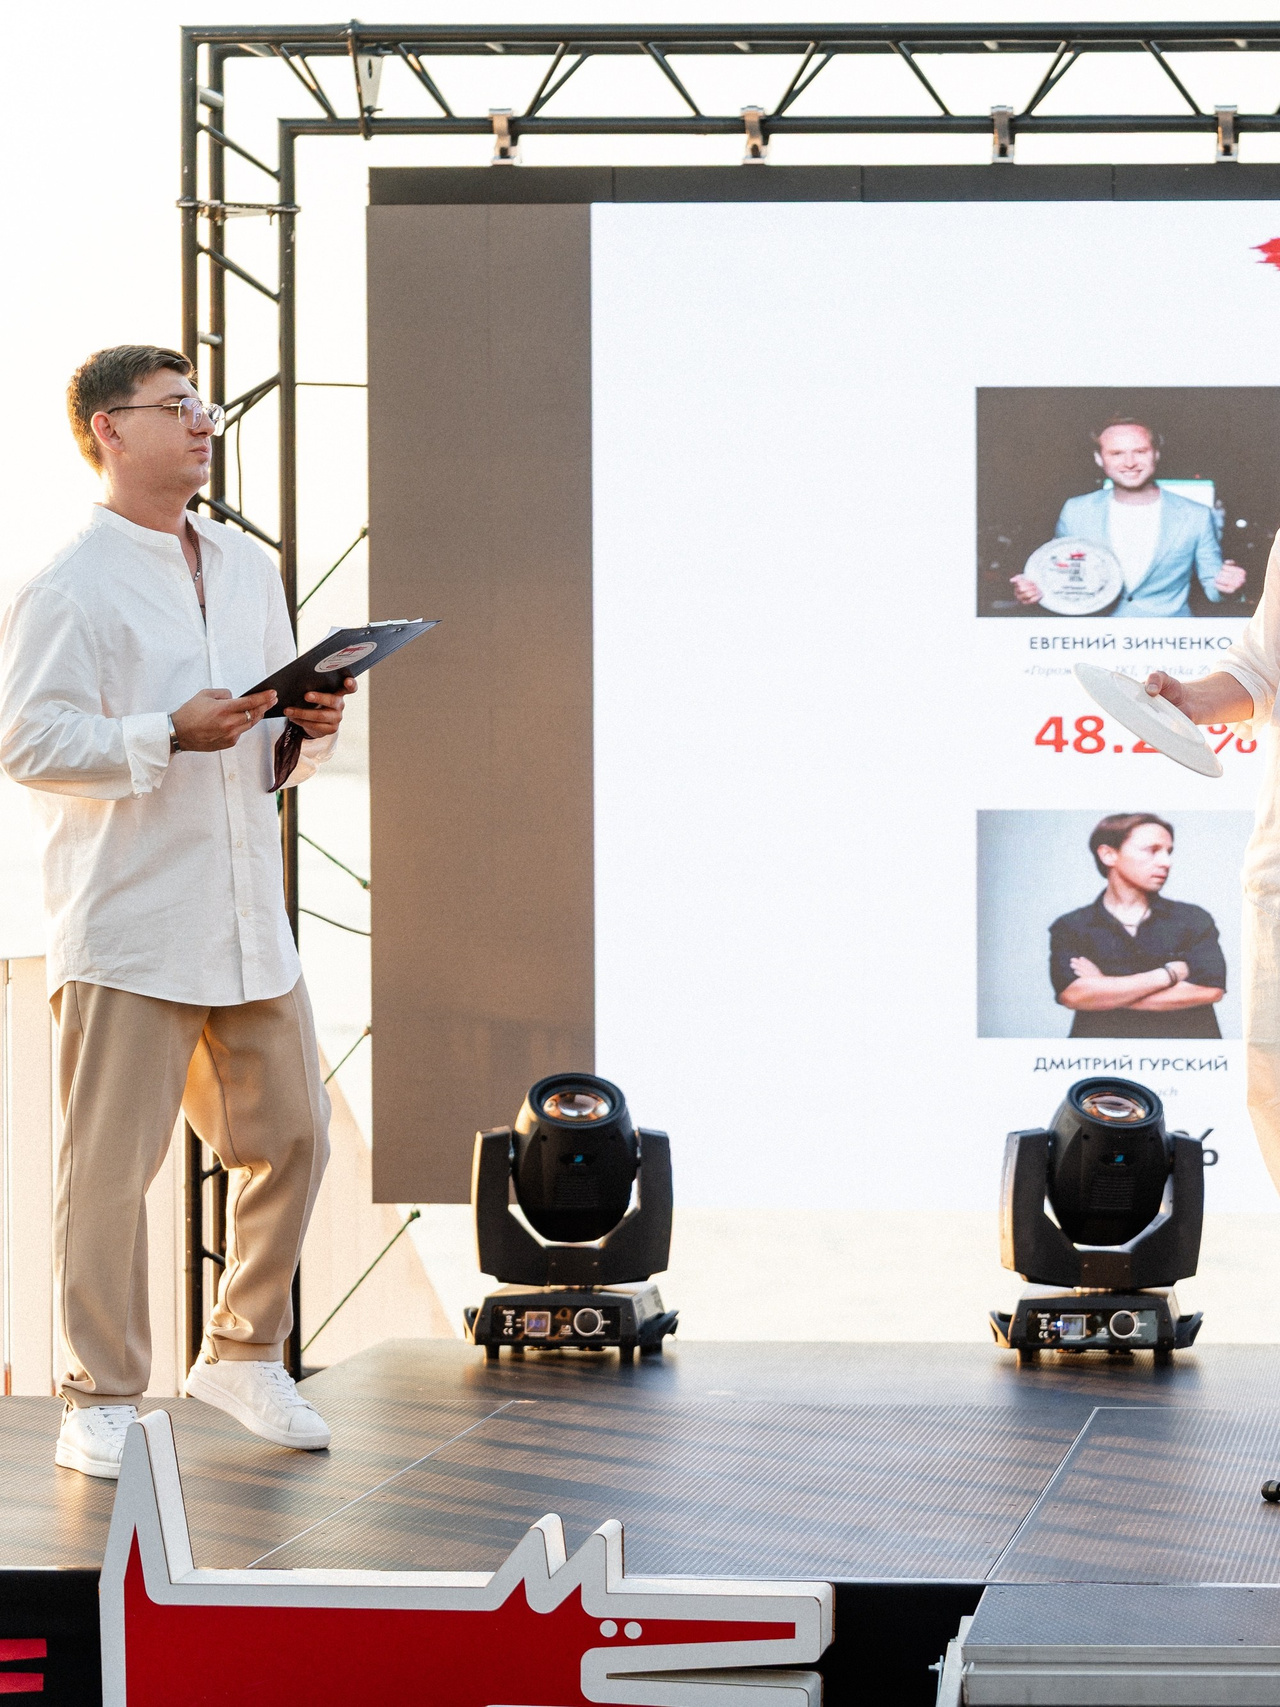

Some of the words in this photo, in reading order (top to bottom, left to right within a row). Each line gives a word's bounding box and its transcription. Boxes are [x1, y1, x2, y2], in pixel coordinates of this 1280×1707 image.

[1029, 634, 1116, 650] ЕВГЕНИЙ
[1123, 636, 1233, 650] ЗИНЧЕНКО
[1033, 1055, 1133, 1073] ДМИТРИЙ
[1139, 1055, 1229, 1071] ГУРСКИЙ
